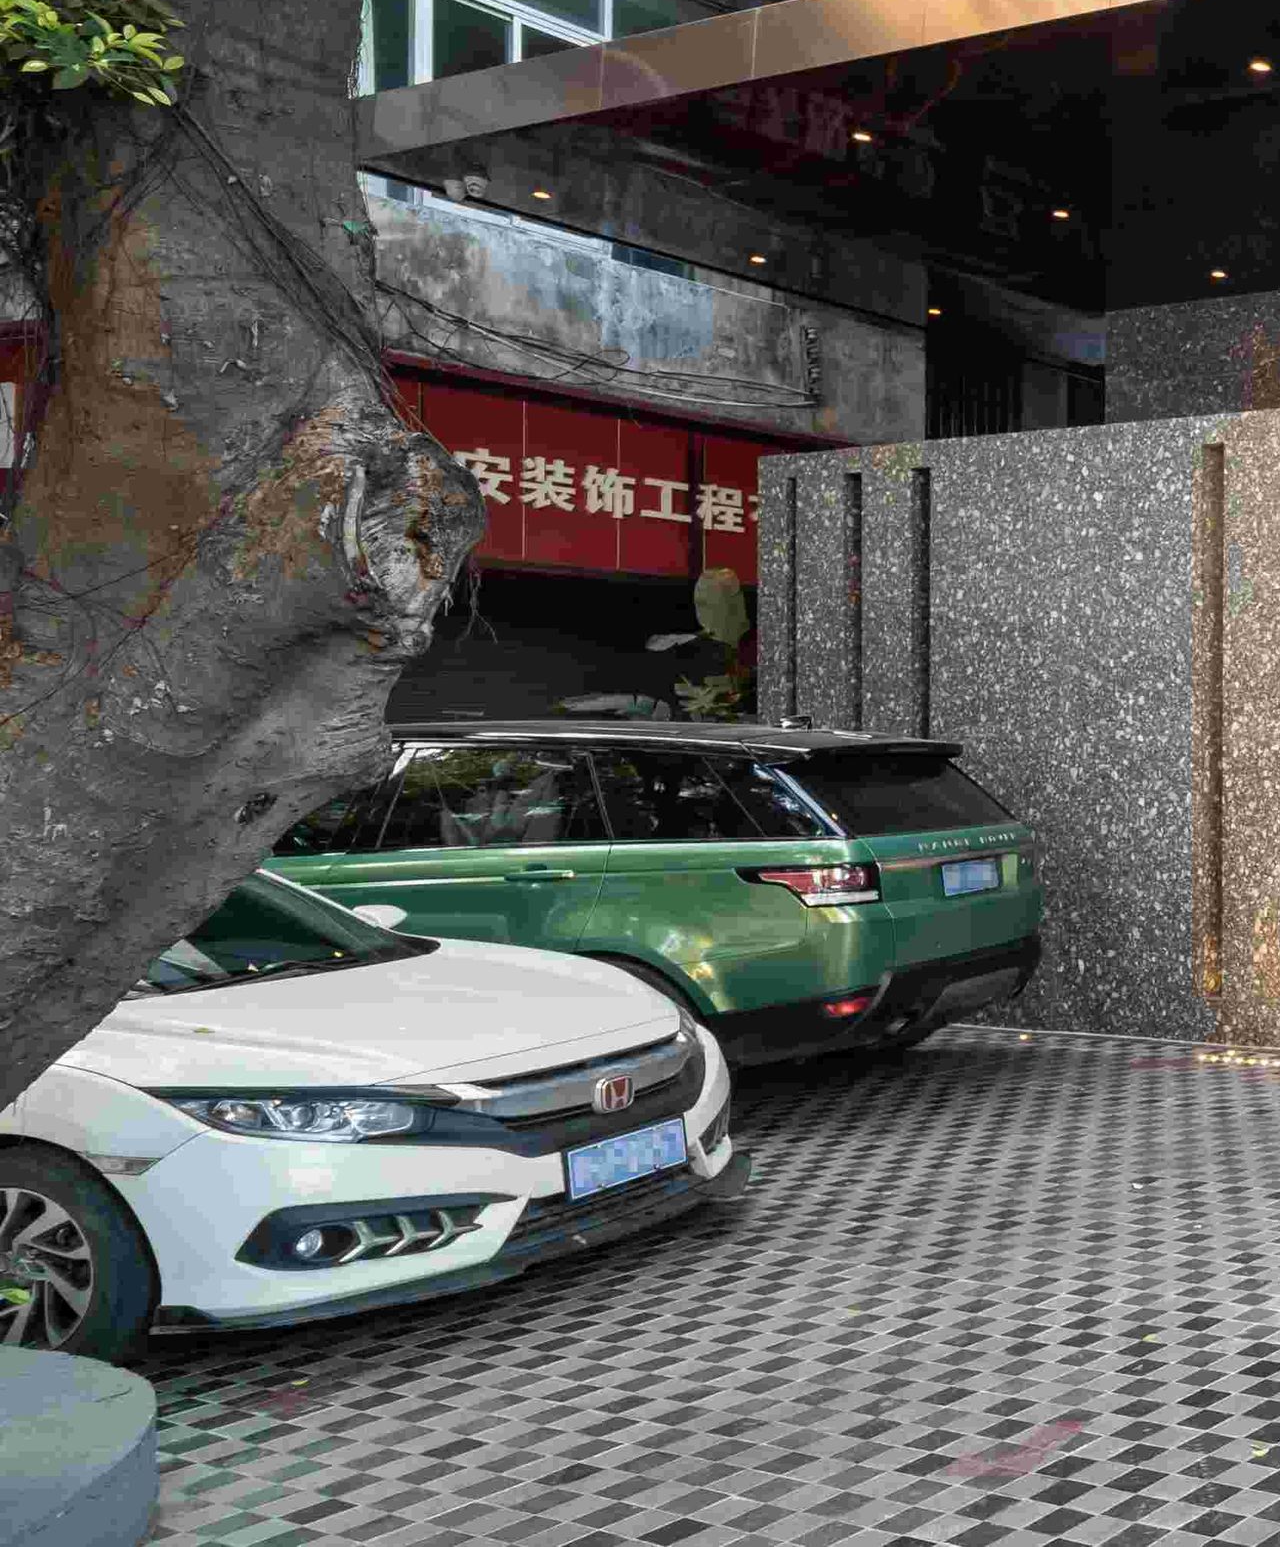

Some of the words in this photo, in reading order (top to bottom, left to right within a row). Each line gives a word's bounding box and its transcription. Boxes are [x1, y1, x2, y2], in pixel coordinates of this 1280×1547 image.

[453, 448, 757, 533] 安装饰工程
